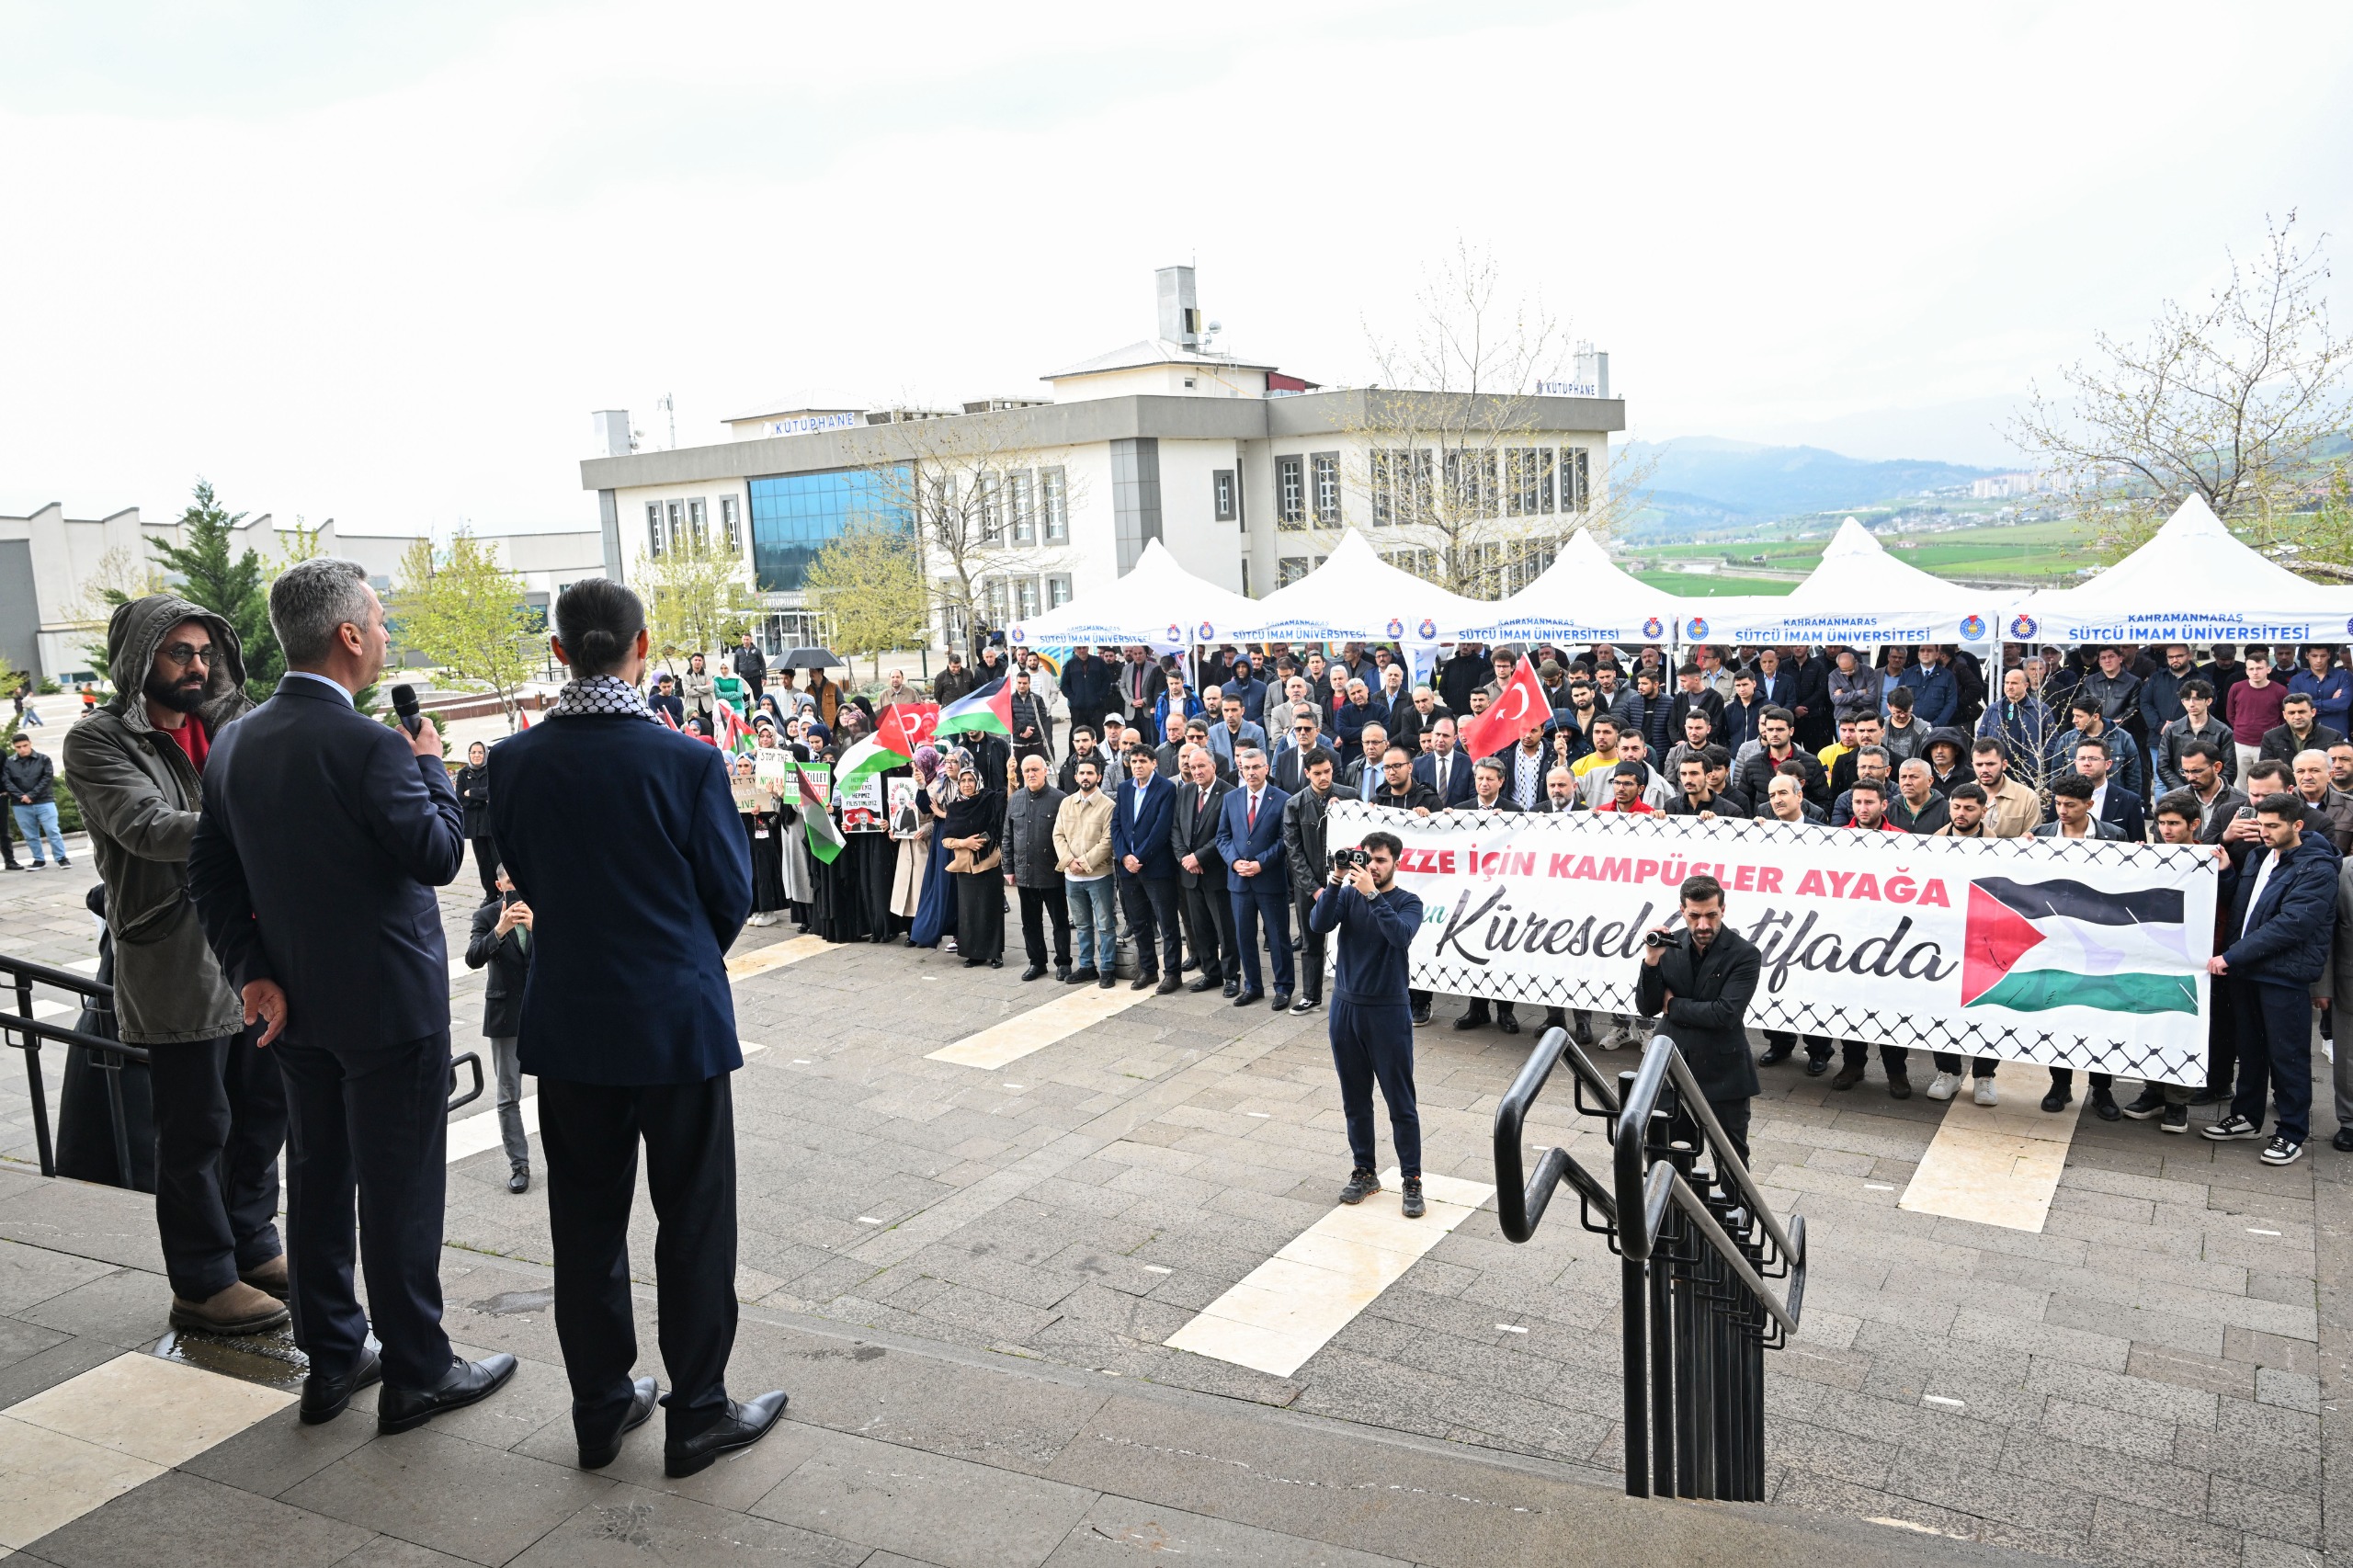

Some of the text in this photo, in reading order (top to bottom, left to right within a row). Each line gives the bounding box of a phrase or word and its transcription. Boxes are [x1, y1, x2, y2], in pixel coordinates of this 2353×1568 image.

[2128, 613, 2244, 624] KAHRAMANMARAŞ
[1068, 632, 1091, 643] İMAM
[1267, 628, 1294, 640] İMAM
[1459, 627, 1620, 642] SÜTÇÜ İMAM ÜNİVERSİTESİ
[1735, 627, 1930, 644] SÜTÇÜ İMAM ÜNİVERSİTESİ
[2068, 623, 2310, 643] SÜTÇÜ İMAM ÜNİVERSİTESİ
[761, 753, 776, 761] STOP
[1355, 843, 1951, 908] ZZE İÇİN KAMPÜSLER AYAĞA
[1435, 884, 1960, 994] Küresel tifada
